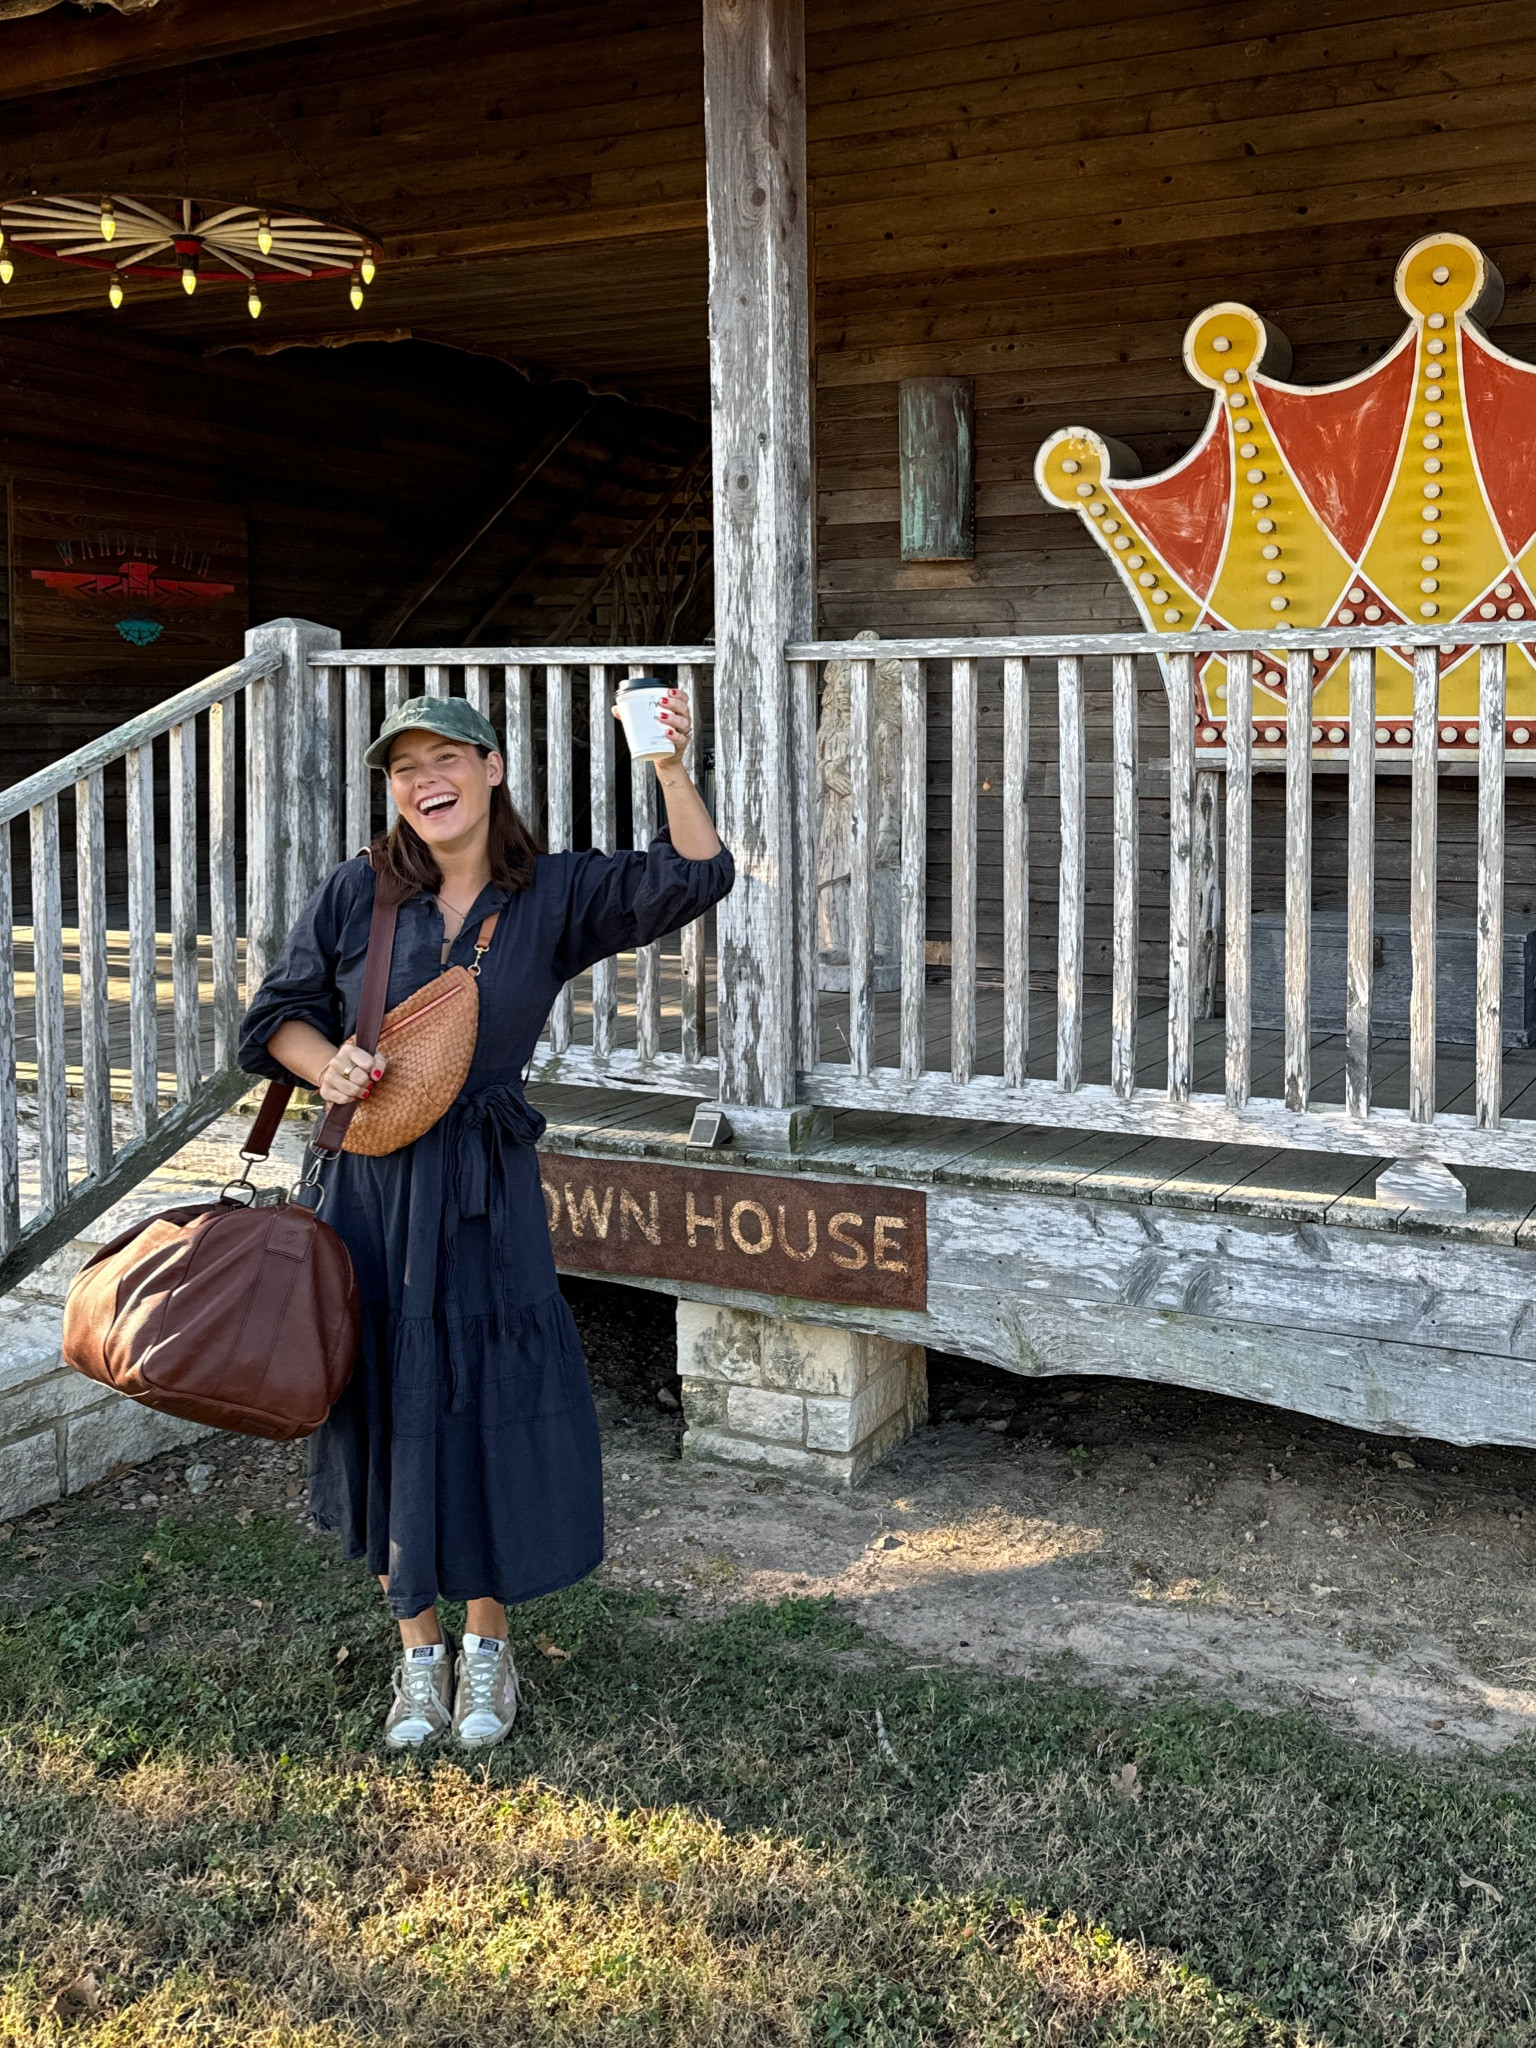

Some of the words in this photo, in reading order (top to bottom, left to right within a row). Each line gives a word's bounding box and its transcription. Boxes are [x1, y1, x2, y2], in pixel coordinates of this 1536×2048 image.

[56, 533, 158, 566] WANDER
[172, 542, 211, 578] INN
[686, 1191, 909, 1273] HOUSE
